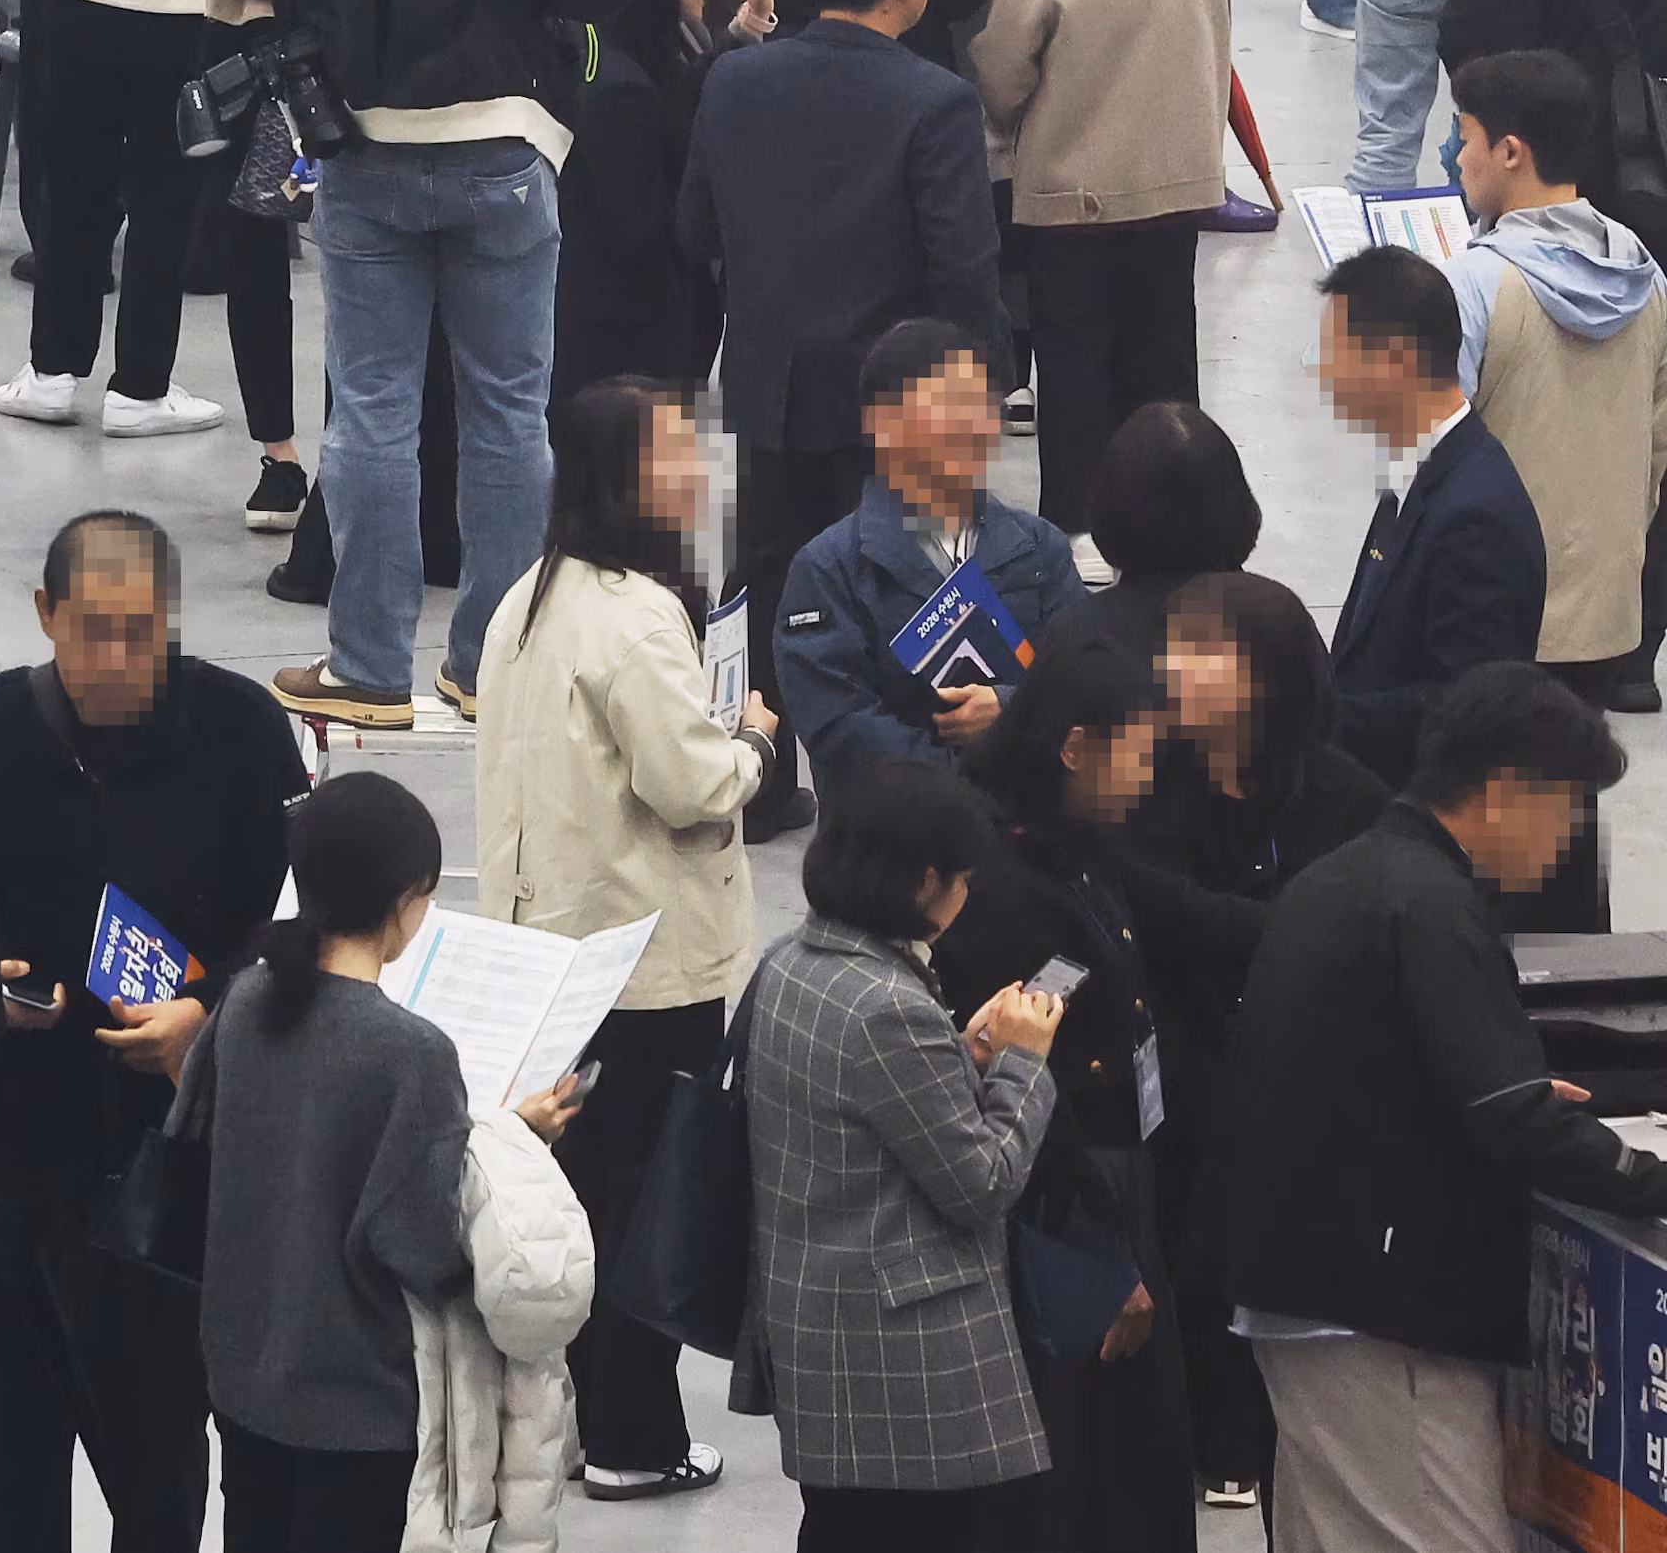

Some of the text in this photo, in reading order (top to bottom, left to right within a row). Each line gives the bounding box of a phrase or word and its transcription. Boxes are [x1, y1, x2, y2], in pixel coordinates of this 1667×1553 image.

[916, 586, 962, 639] 2026 수원시
[101, 914, 123, 975] 2026 수원시
[119, 925, 151, 1001] 일자리
[152, 942, 182, 1003] 람회
